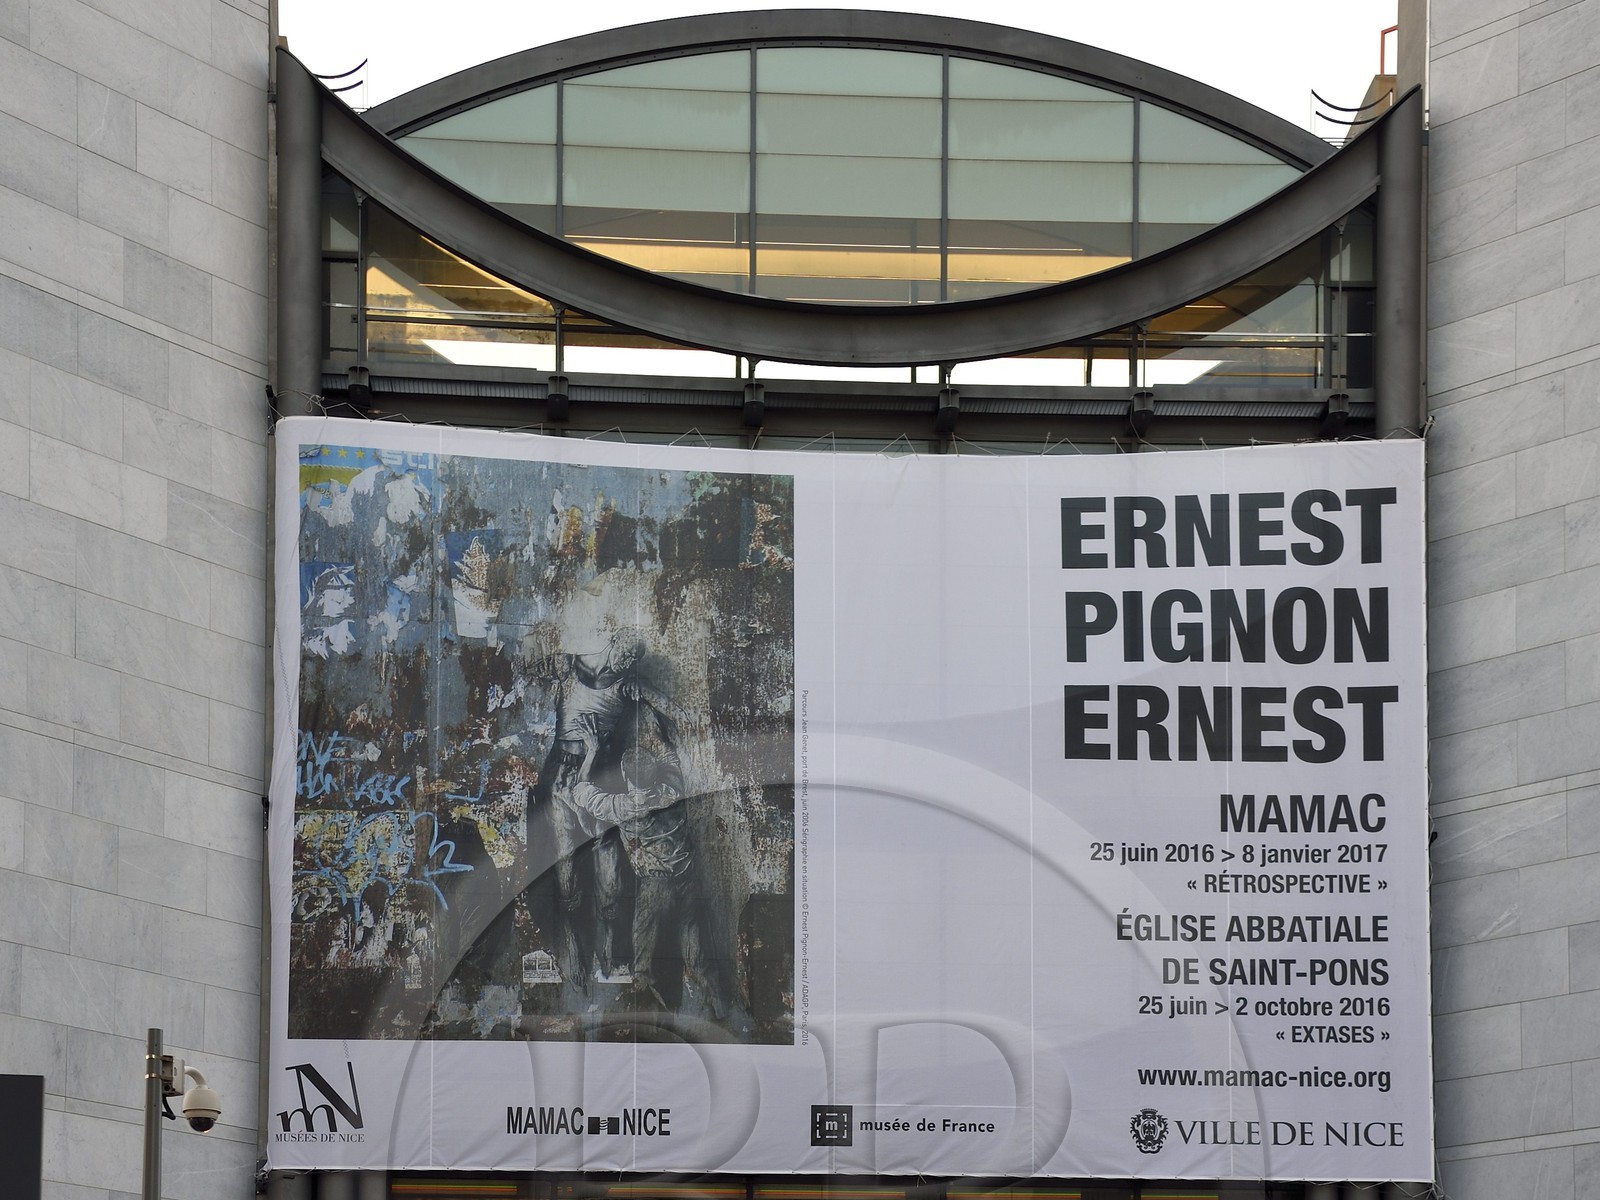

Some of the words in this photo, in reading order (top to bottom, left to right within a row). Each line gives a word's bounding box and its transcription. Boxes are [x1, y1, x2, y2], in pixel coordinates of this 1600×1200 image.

[1061, 487, 1397, 569] ERNEST
[1065, 587, 1389, 664] PIGNON
[800, 690, 809, 717] Parcours
[800, 718, 809, 733] Jean
[1064, 684, 1399, 763] ERNEST
[800, 755, 809, 768] port
[800, 770, 809, 778] de
[800, 798, 809, 810] juin
[1220, 793, 1386, 833] MAMAC
[800, 812, 809, 826] 2006
[1090, 842, 1114, 861] 25
[1121, 843, 1158, 865] juin
[1165, 844, 1214, 862] 2016
[1242, 844, 1255, 862] 8
[1260, 844, 1331, 867] janvier
[1335, 844, 1387, 863] 2017
[800, 865, 809, 874] en
[1204, 870, 1370, 893] RÉTROSPECTIVE
[800, 874, 809, 902] situation
[800, 911, 809, 932] Ernest
[1116, 908, 1216, 942] ÉGLISE
[1225, 915, 1389, 942] ABBATIALE
[800, 933, 809, 979] Pignon-Ernest
[1162, 958, 1199, 985] DE
[1209, 958, 1389, 986] SAINT-PONS
[1138, 997, 1163, 1014] 25
[1169, 996, 1207, 1018] juin
[1236, 998, 1248, 1015] 2
[1254, 997, 1332, 1016] octobre
[1339, 998, 1390, 1016] 2016
[1291, 1025, 1374, 1043] EXTASES
[1138, 1066, 1391, 1092] www.mamac-nice.org
[506, 1106, 584, 1135] MAMAC
[623, 1108, 671, 1136] NICE
[860, 1118, 910, 1131] musée
[916, 1119, 936, 1132] de
[942, 1119, 995, 1133] France
[1174, 1119, 1262, 1145] VILLE
[1270, 1121, 1314, 1146] DE
[1324, 1121, 1404, 1147] NICE
[275, 1130, 318, 1143] MUSÉES
[320, 1133, 335, 1142] DE
[338, 1133, 364, 1143] NICE
